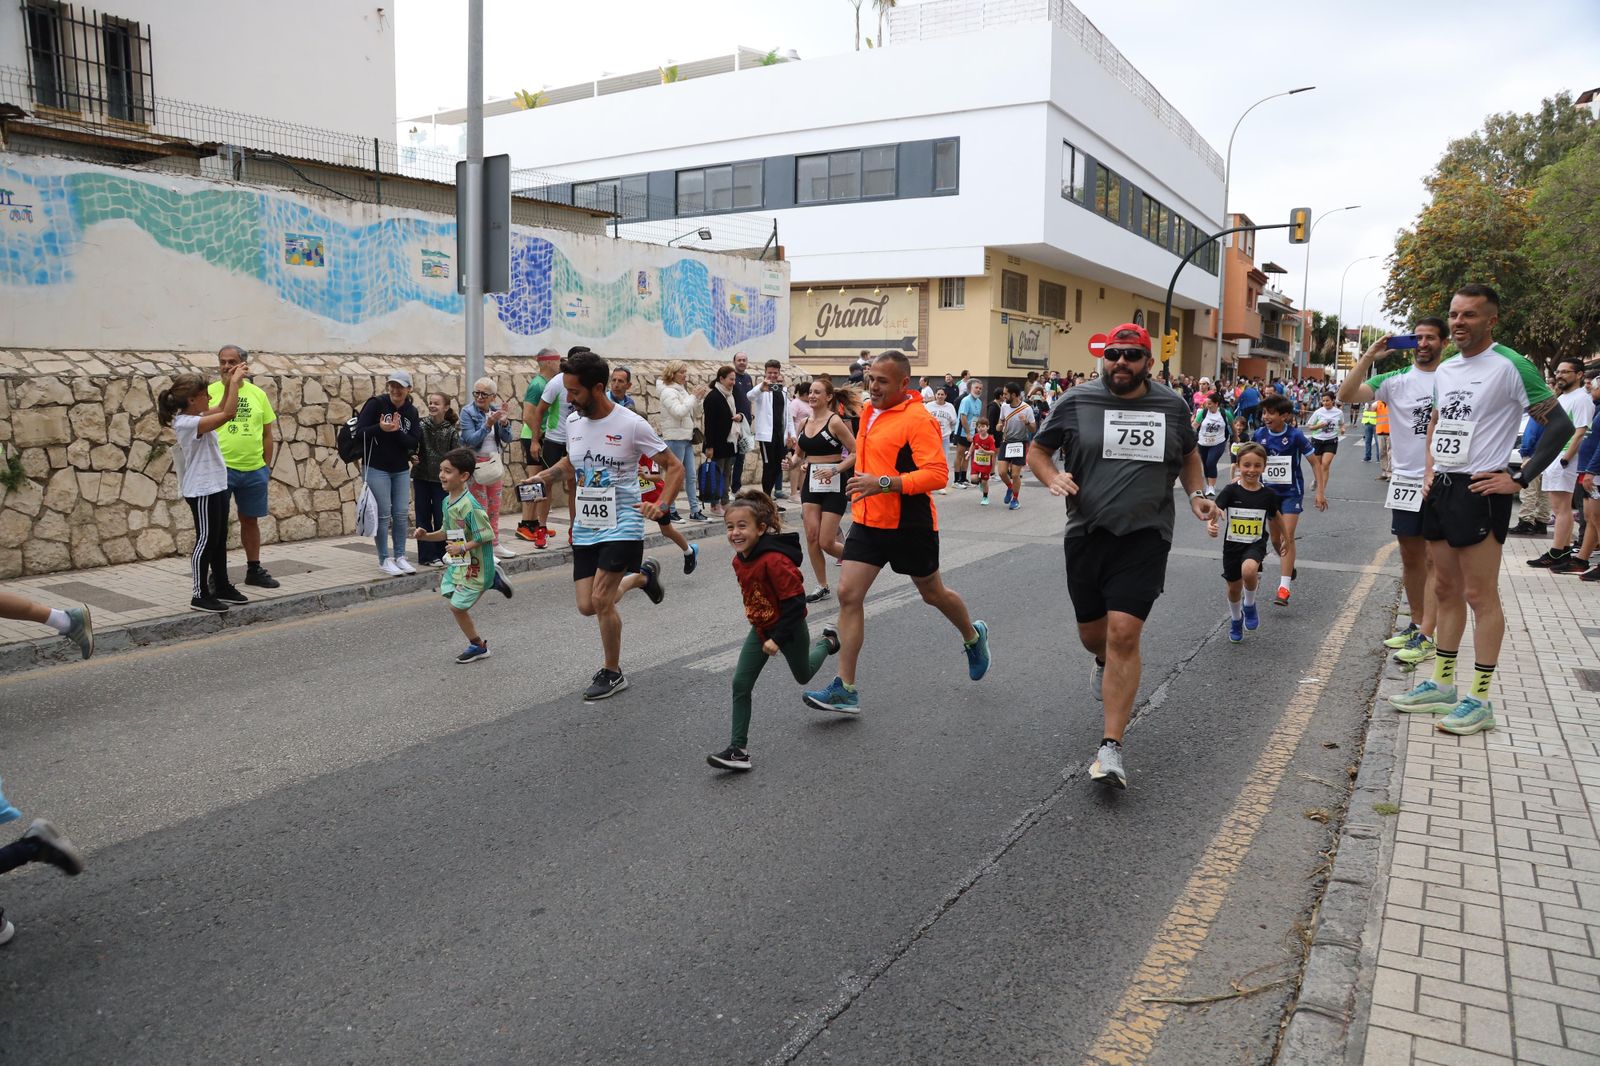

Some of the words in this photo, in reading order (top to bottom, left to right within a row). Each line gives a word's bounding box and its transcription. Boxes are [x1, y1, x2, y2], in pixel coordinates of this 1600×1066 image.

[815, 294, 890, 338] Grand
[1017, 329, 1041, 357] Grand
[1117, 428, 1155, 447] 758
[1436, 437, 1461, 454] 623
[595, 453, 625, 470] Málaga
[1267, 467, 1287, 477] 609
[1393, 488, 1417, 502] 877
[582, 504, 608, 518] 448
[1232, 523, 1260, 535] 1011
